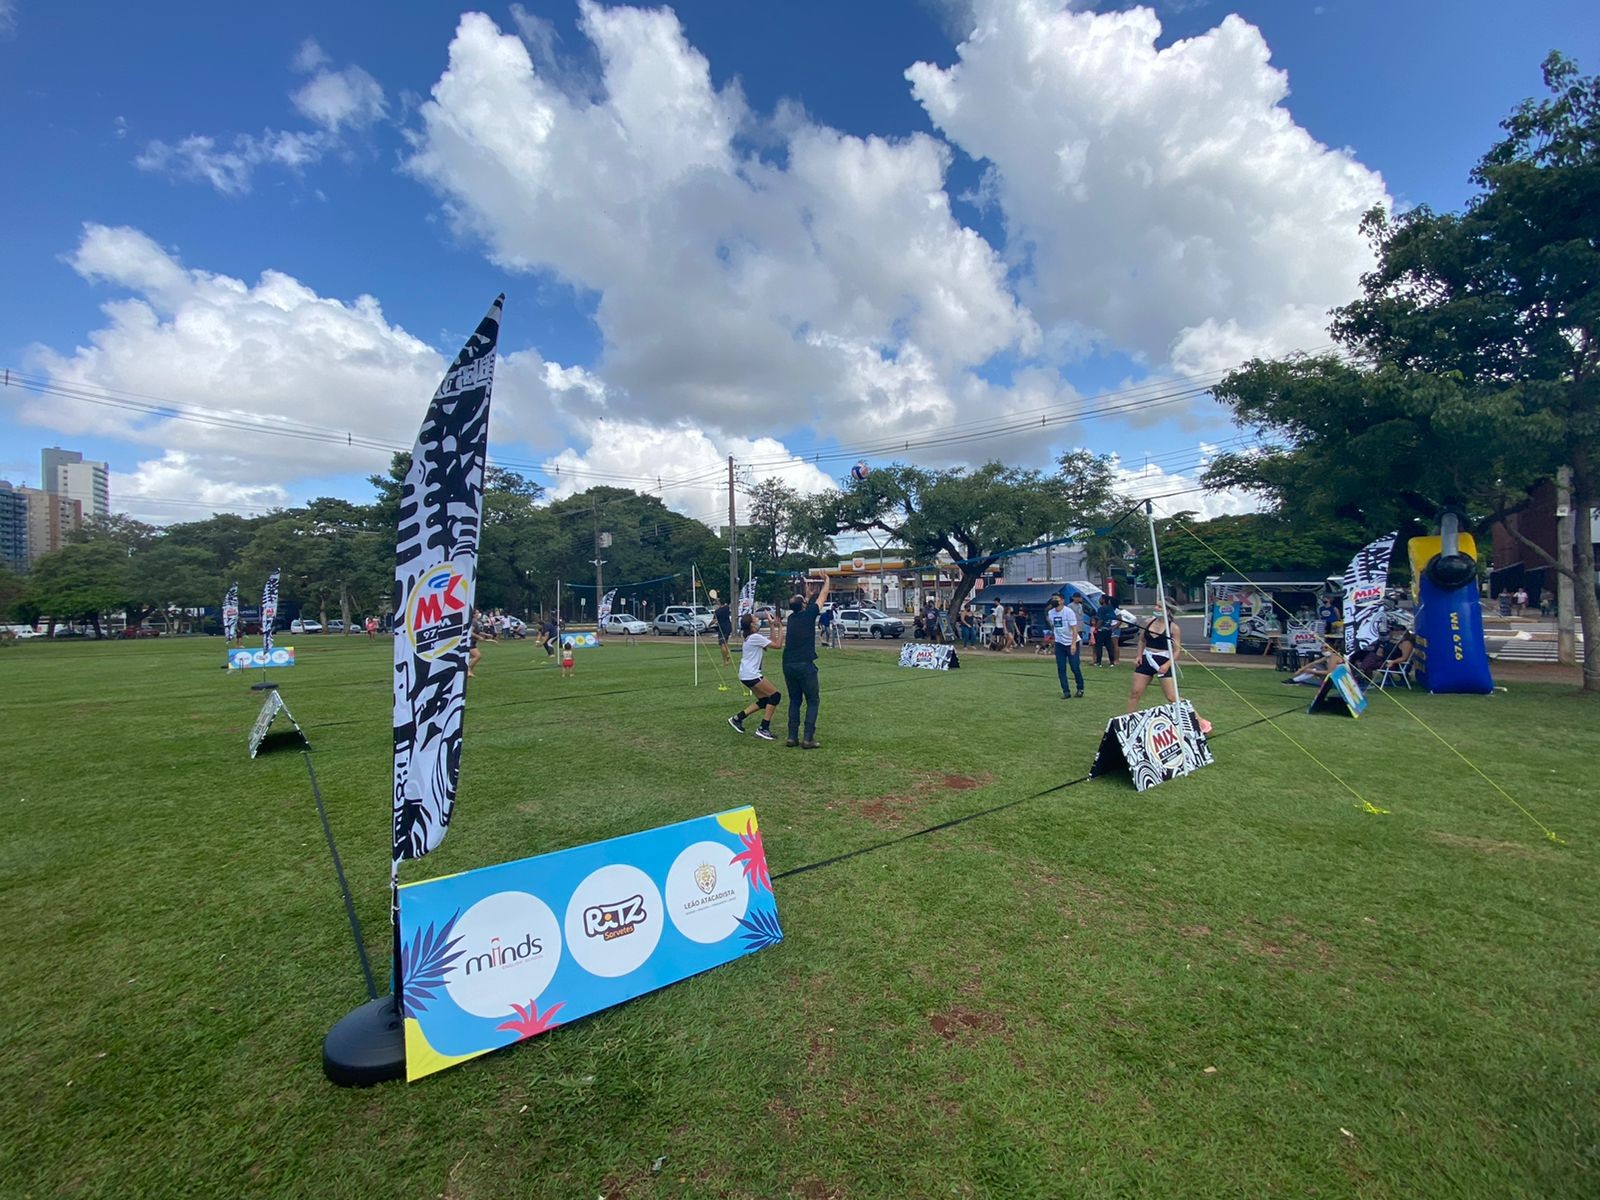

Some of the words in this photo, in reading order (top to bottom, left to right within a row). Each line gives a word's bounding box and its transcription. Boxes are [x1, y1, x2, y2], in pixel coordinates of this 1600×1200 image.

[1354, 586, 1381, 600] MIX
[1450, 612, 1460, 631] FM
[1294, 633, 1316, 641] MIX
[1454, 634, 1464, 660] 97.9
[1152, 725, 1178, 753] MIX
[604, 926, 634, 940] Sorvetes
